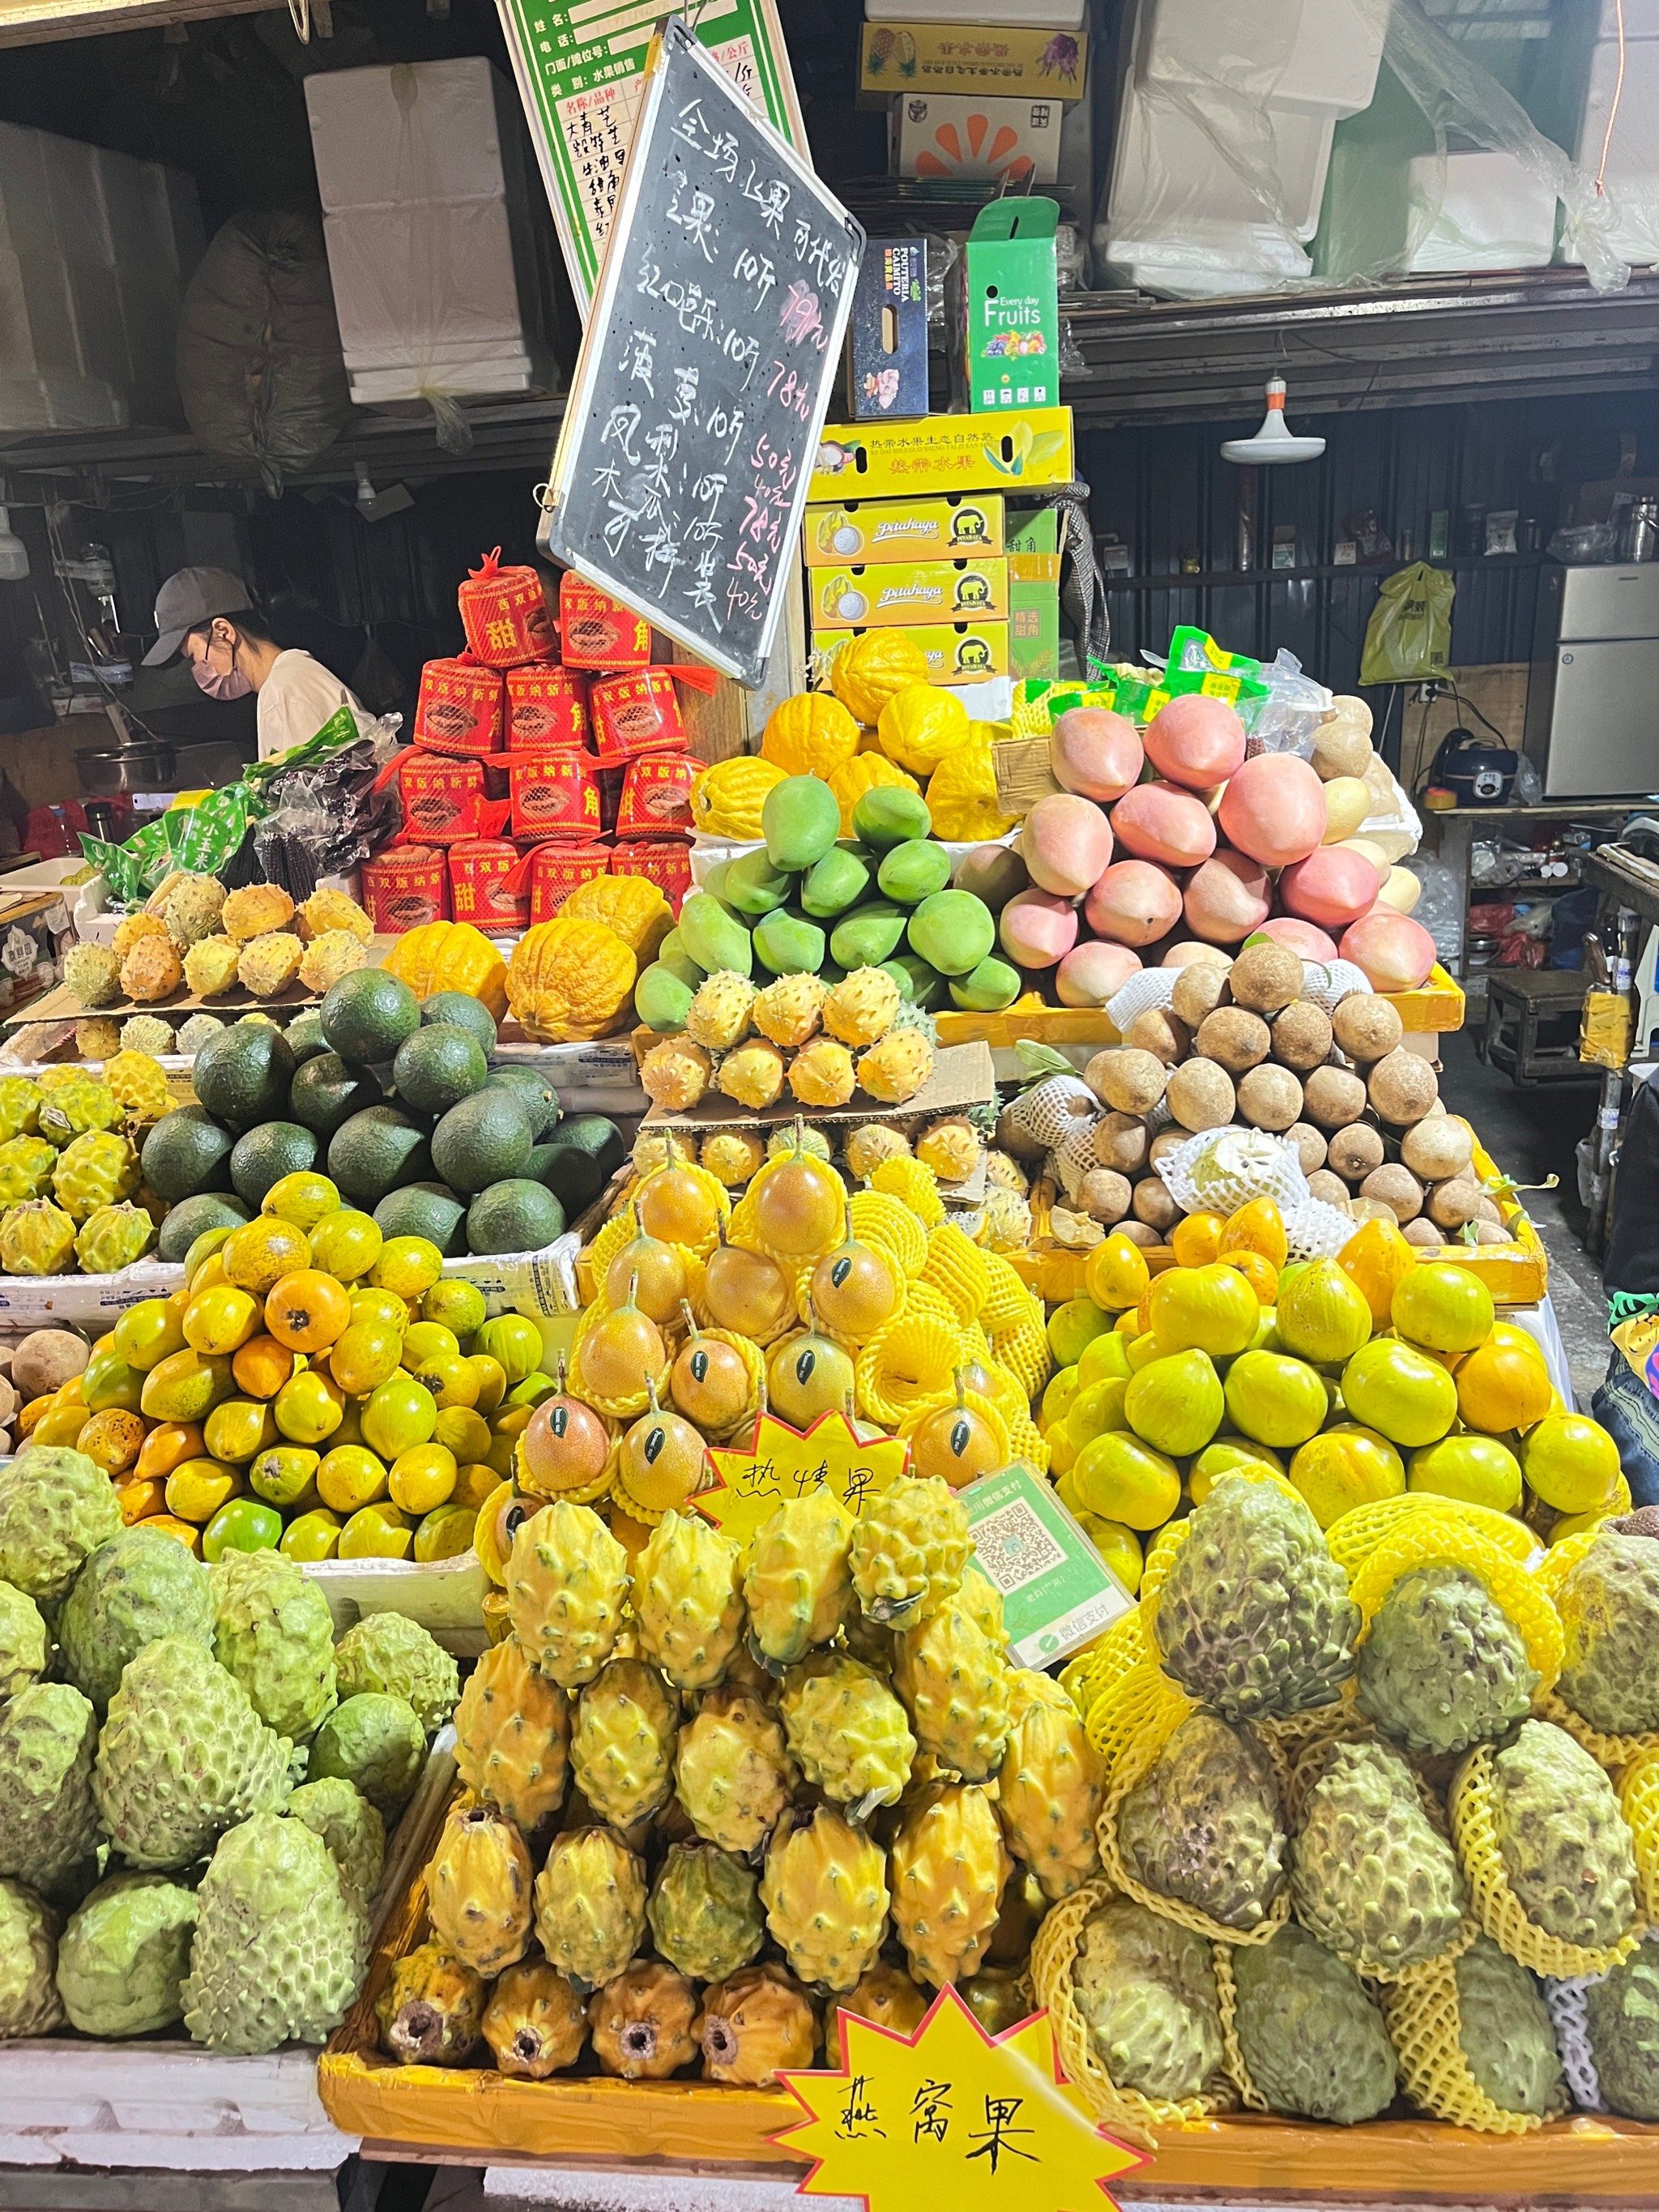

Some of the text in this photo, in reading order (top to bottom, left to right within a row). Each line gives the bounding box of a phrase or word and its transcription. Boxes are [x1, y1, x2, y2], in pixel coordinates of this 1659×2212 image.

[592, 58, 636, 83] 水果销售
[566, 87, 616, 115] 名称/品种
[892, 247, 902, 297] CAIMITO
[900, 246, 910, 303] POUTERIA
[984, 300, 1042, 327] Fruits
[1000, 295, 1039, 308] Every day
[870, 432, 995, 449] 热带水果生态自然熟
[889, 455, 975, 475] 热带水果
[877, 518, 938, 536] Pitahaya
[881, 583, 943, 602] Pitahaya
[193, 822, 220, 870] 小玉米
[1059, 1603, 1110, 1641] 微信支付
[834, 2074, 1043, 2176] 燕窝果
